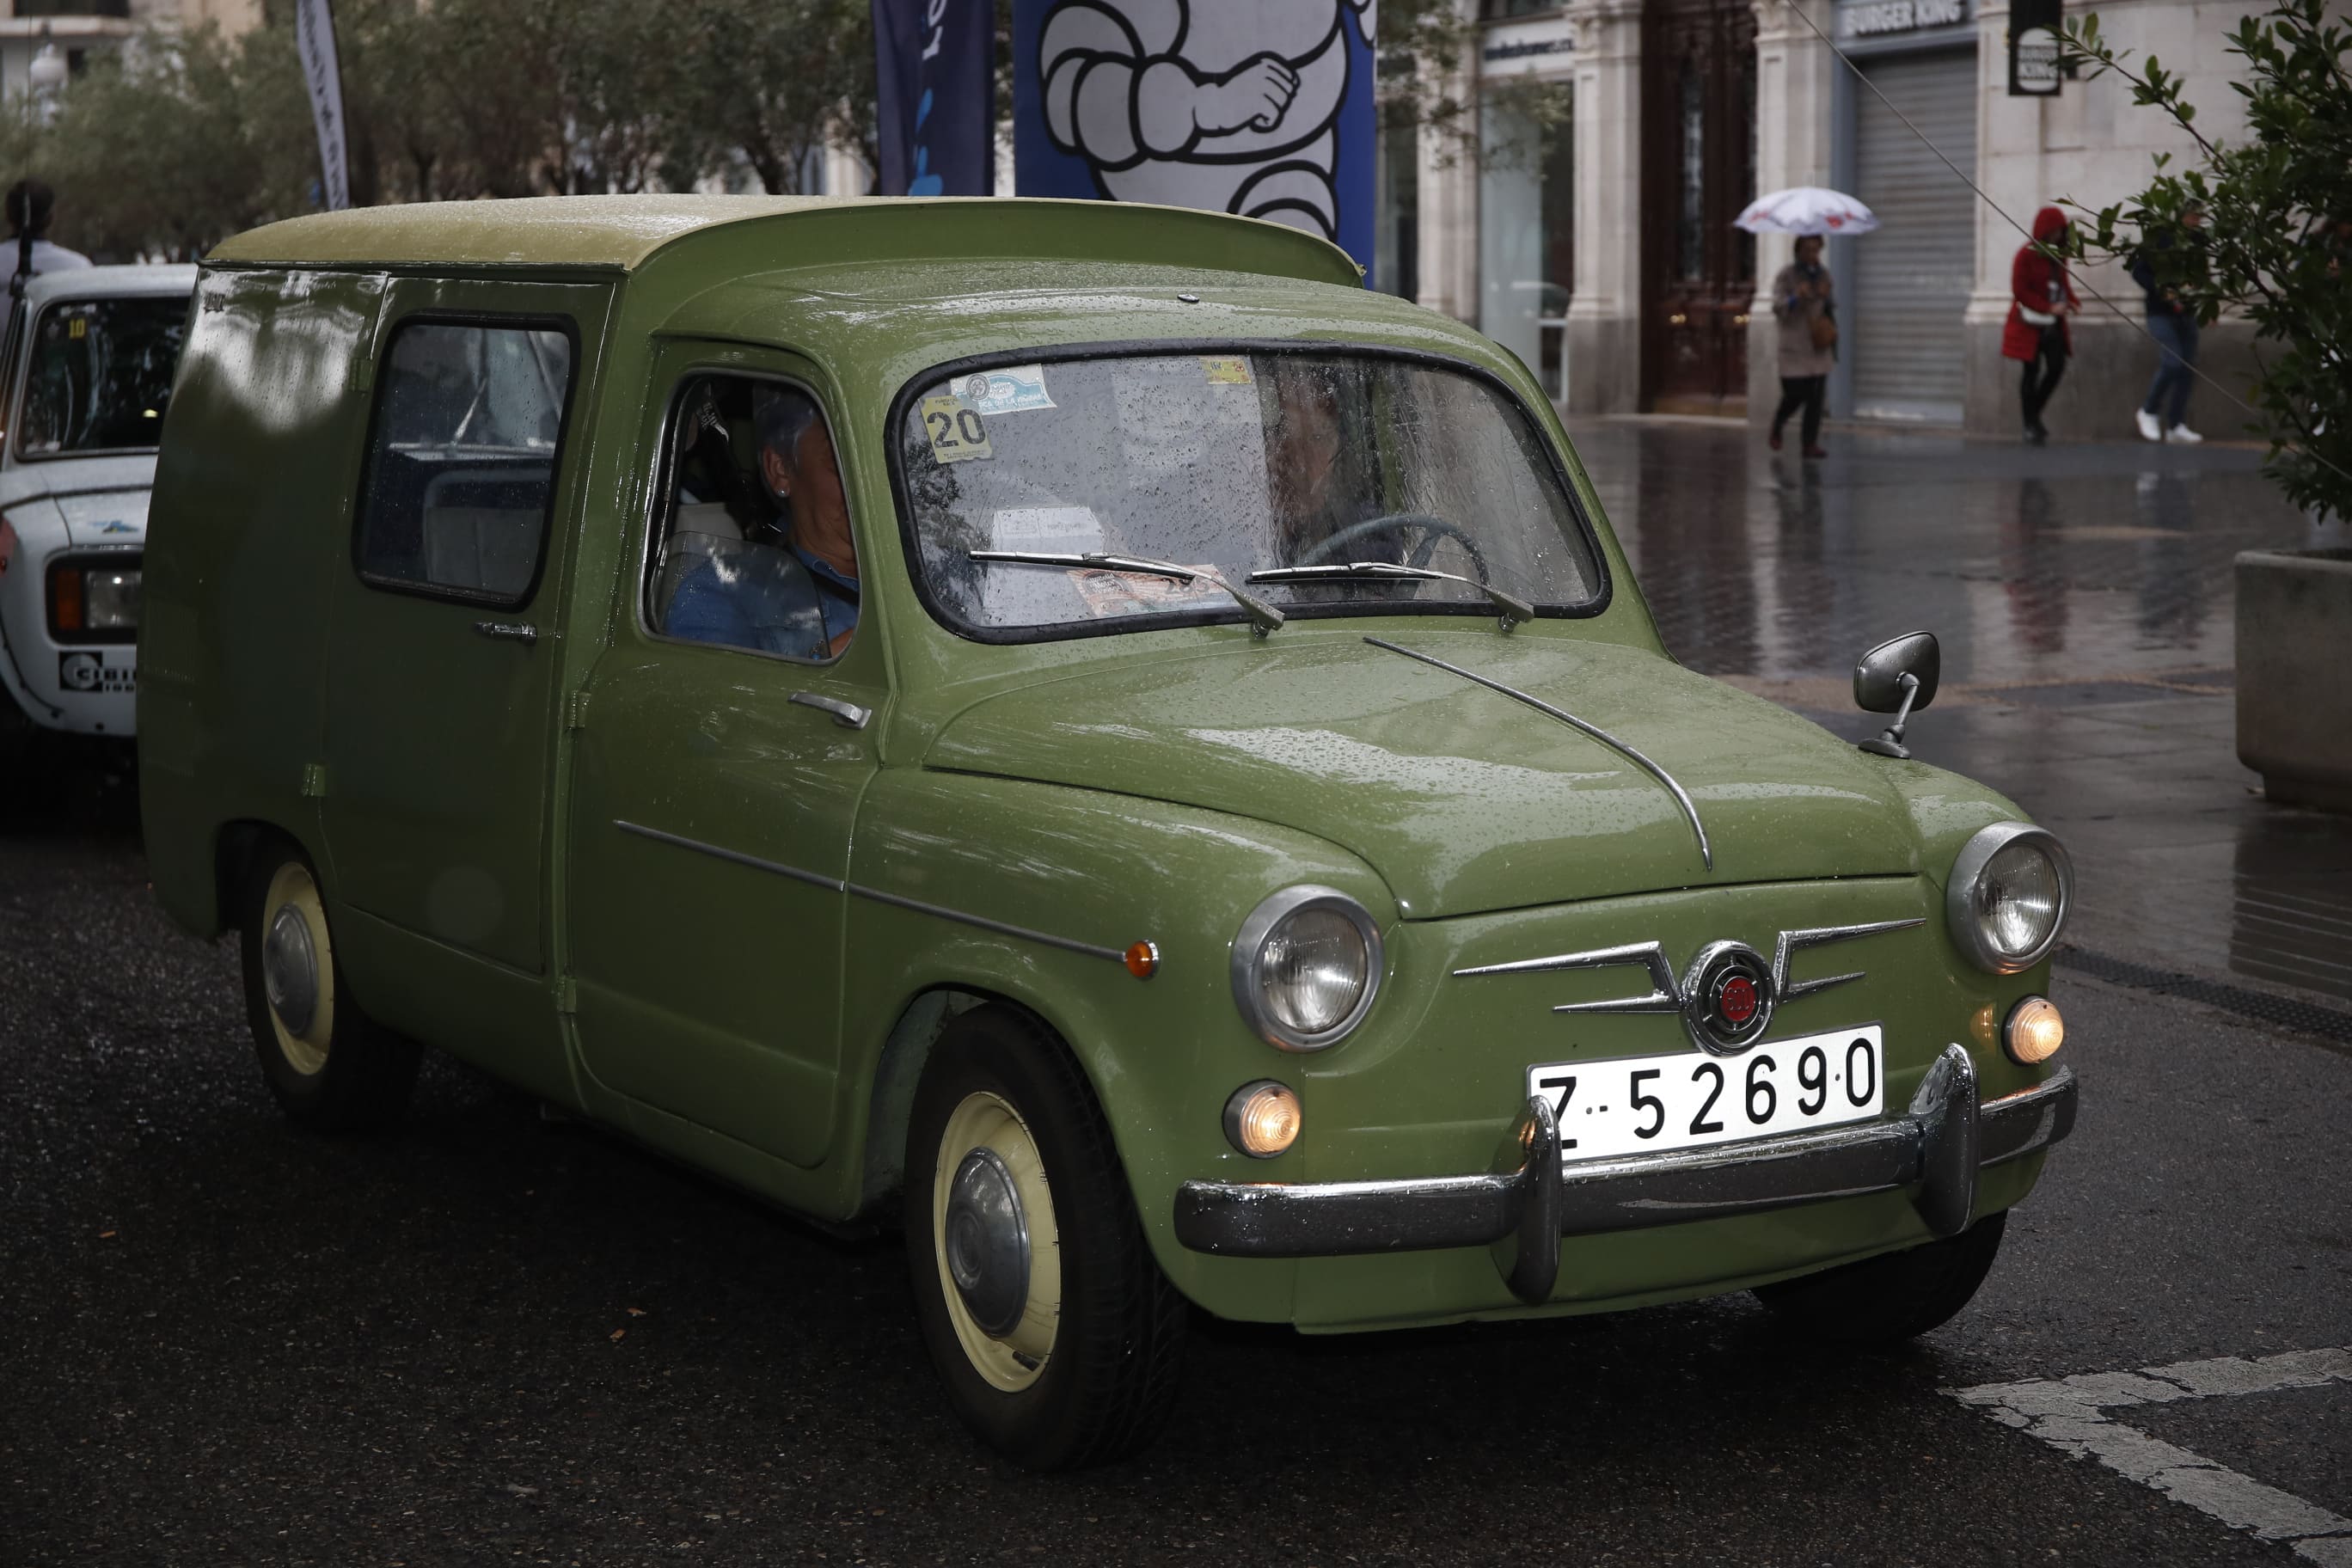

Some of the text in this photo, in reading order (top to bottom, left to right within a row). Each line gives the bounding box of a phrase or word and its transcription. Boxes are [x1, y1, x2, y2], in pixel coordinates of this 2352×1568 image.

[1843, 0, 1961, 34] BURGER KING
[927, 408, 986, 448] 20
